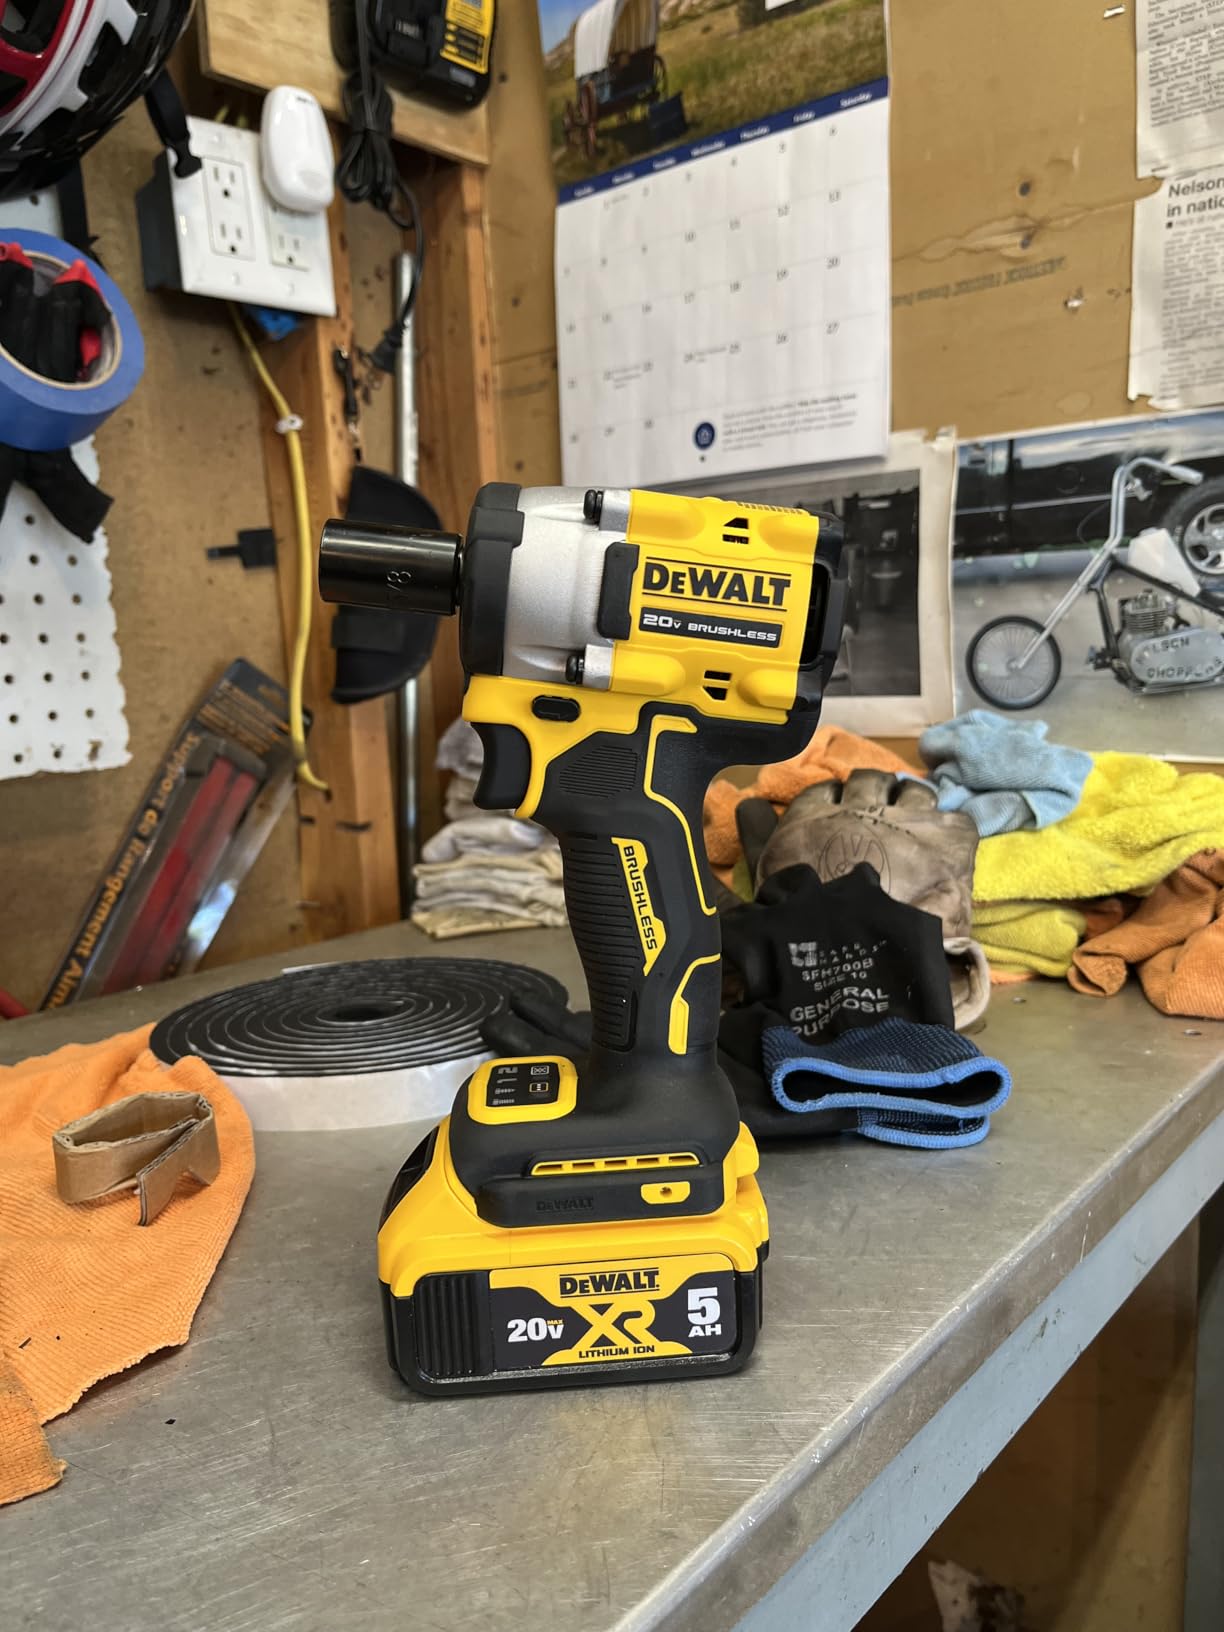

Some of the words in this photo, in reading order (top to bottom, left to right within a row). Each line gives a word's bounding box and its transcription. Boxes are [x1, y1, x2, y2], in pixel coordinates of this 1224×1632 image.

[1168, 177, 1224, 199] Nelson
[1167, 204, 1181, 218] in
[642, 561, 792, 606] DEWALT
[687, 622, 777, 642] BRUSHLESS
[623, 845, 658, 950] BRUSHLESS
[851, 971, 867, 979] 10
[790, 986, 889, 1021] GENERAL
[536, 1196, 594, 1211] DEWALT
[559, 1271, 660, 1295] DEWALT
[687, 1287, 721, 1325] 5
[571, 1301, 661, 1347] XR
[688, 1324, 722, 1338] AH
[578, 1347, 629, 1359] LITHIUM
[633, 1345, 655, 1355] ION
